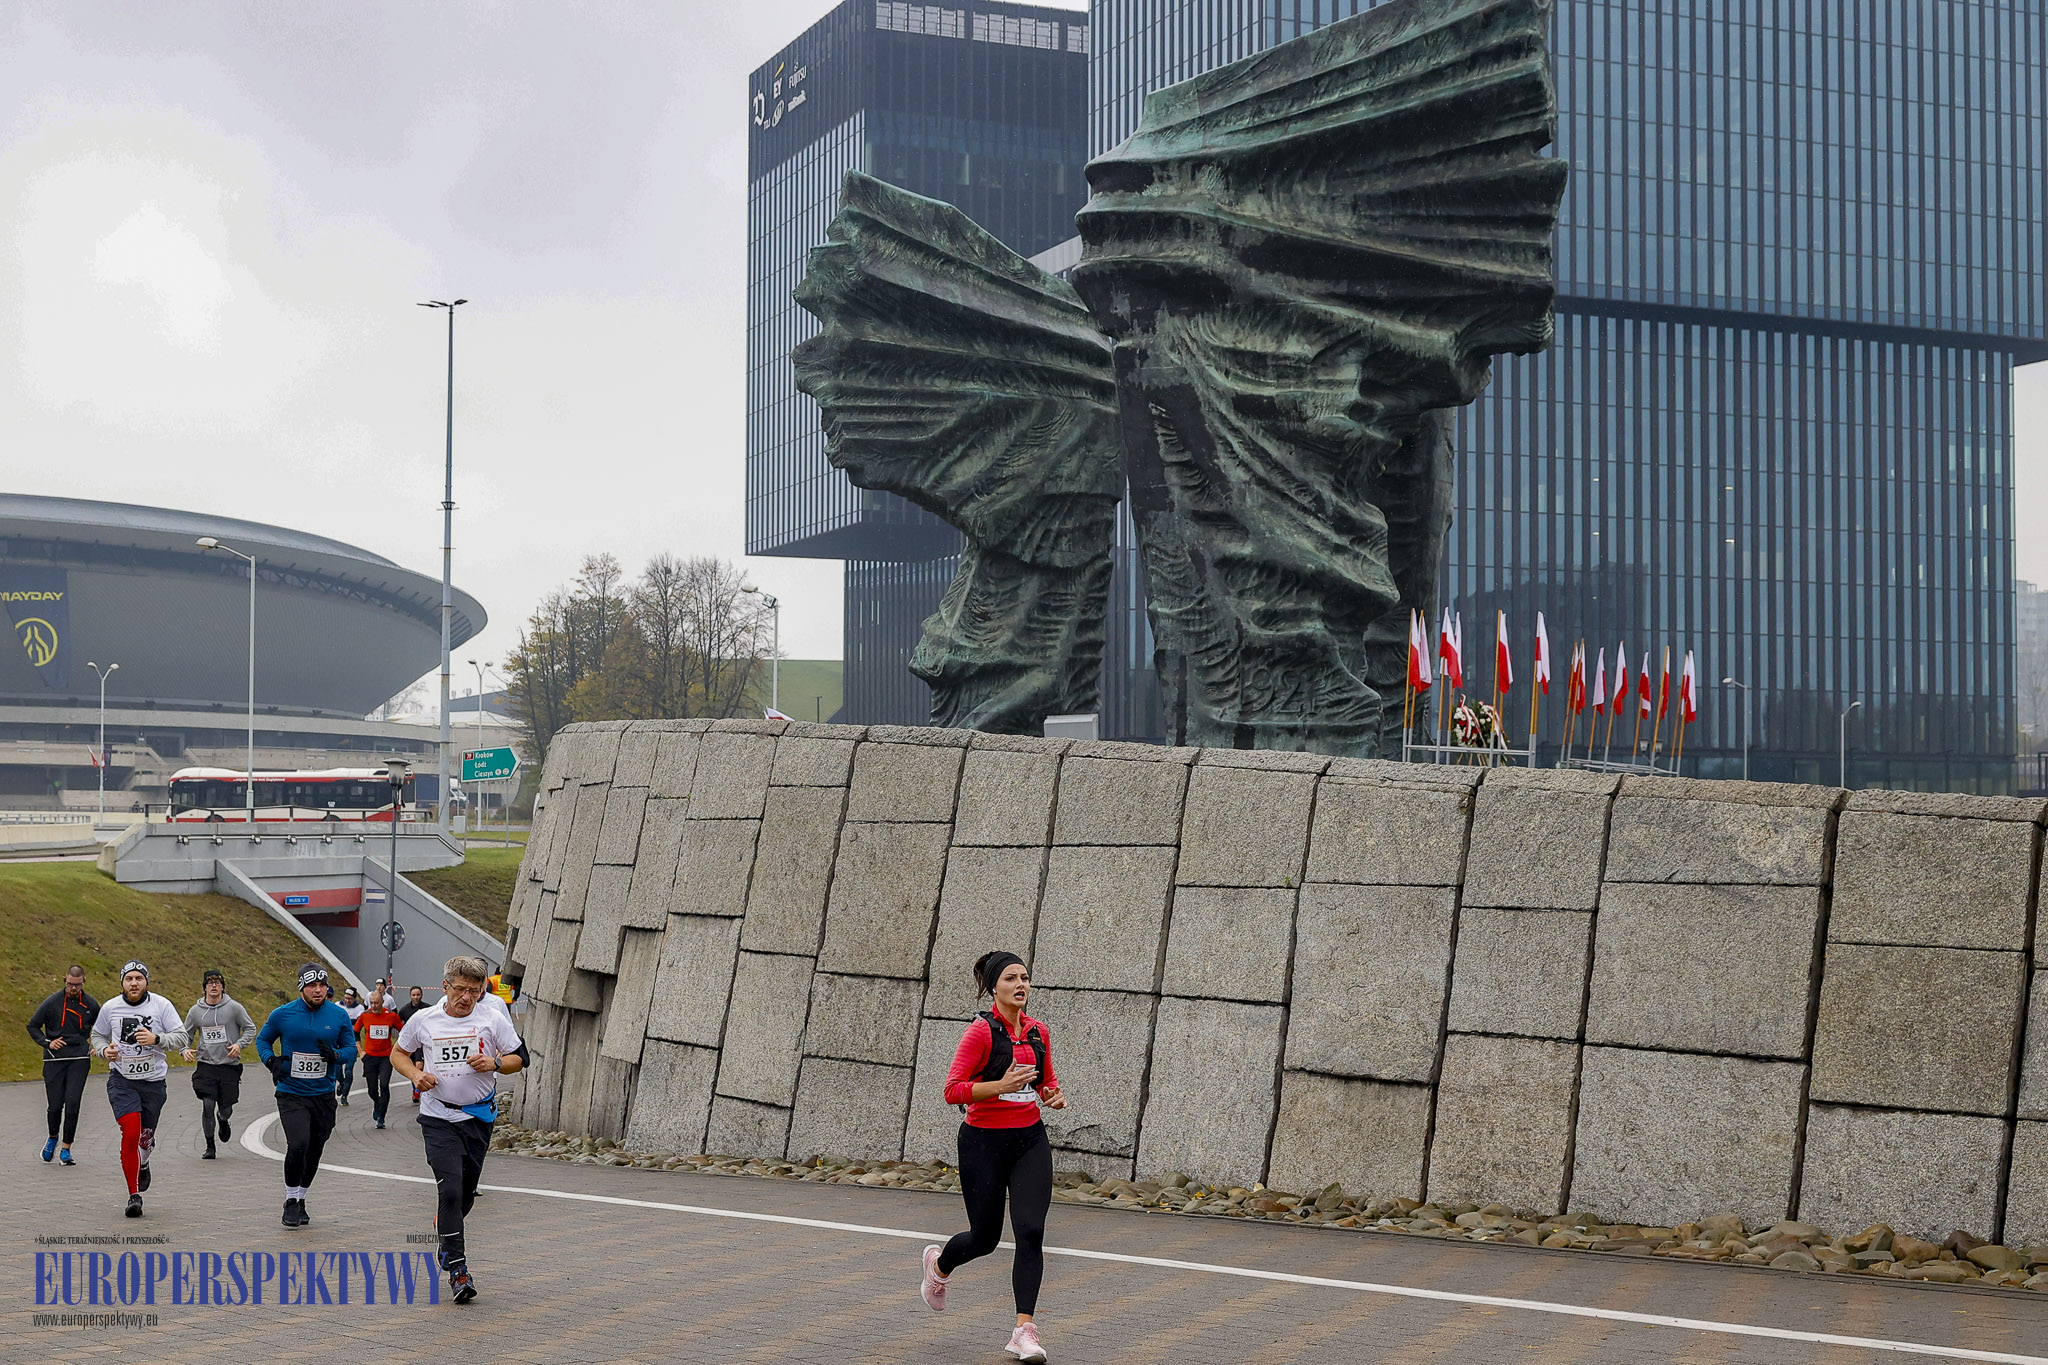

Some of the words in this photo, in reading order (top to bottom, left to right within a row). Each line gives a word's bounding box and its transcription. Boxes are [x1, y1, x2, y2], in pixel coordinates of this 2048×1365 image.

[773, 77, 783, 99] EY
[0, 591, 63, 601] MAYDAY
[206, 1031, 222, 1040] 595
[441, 1046, 469, 1061] 557
[128, 1062, 150, 1073] 260
[298, 1061, 320, 1072] 382
